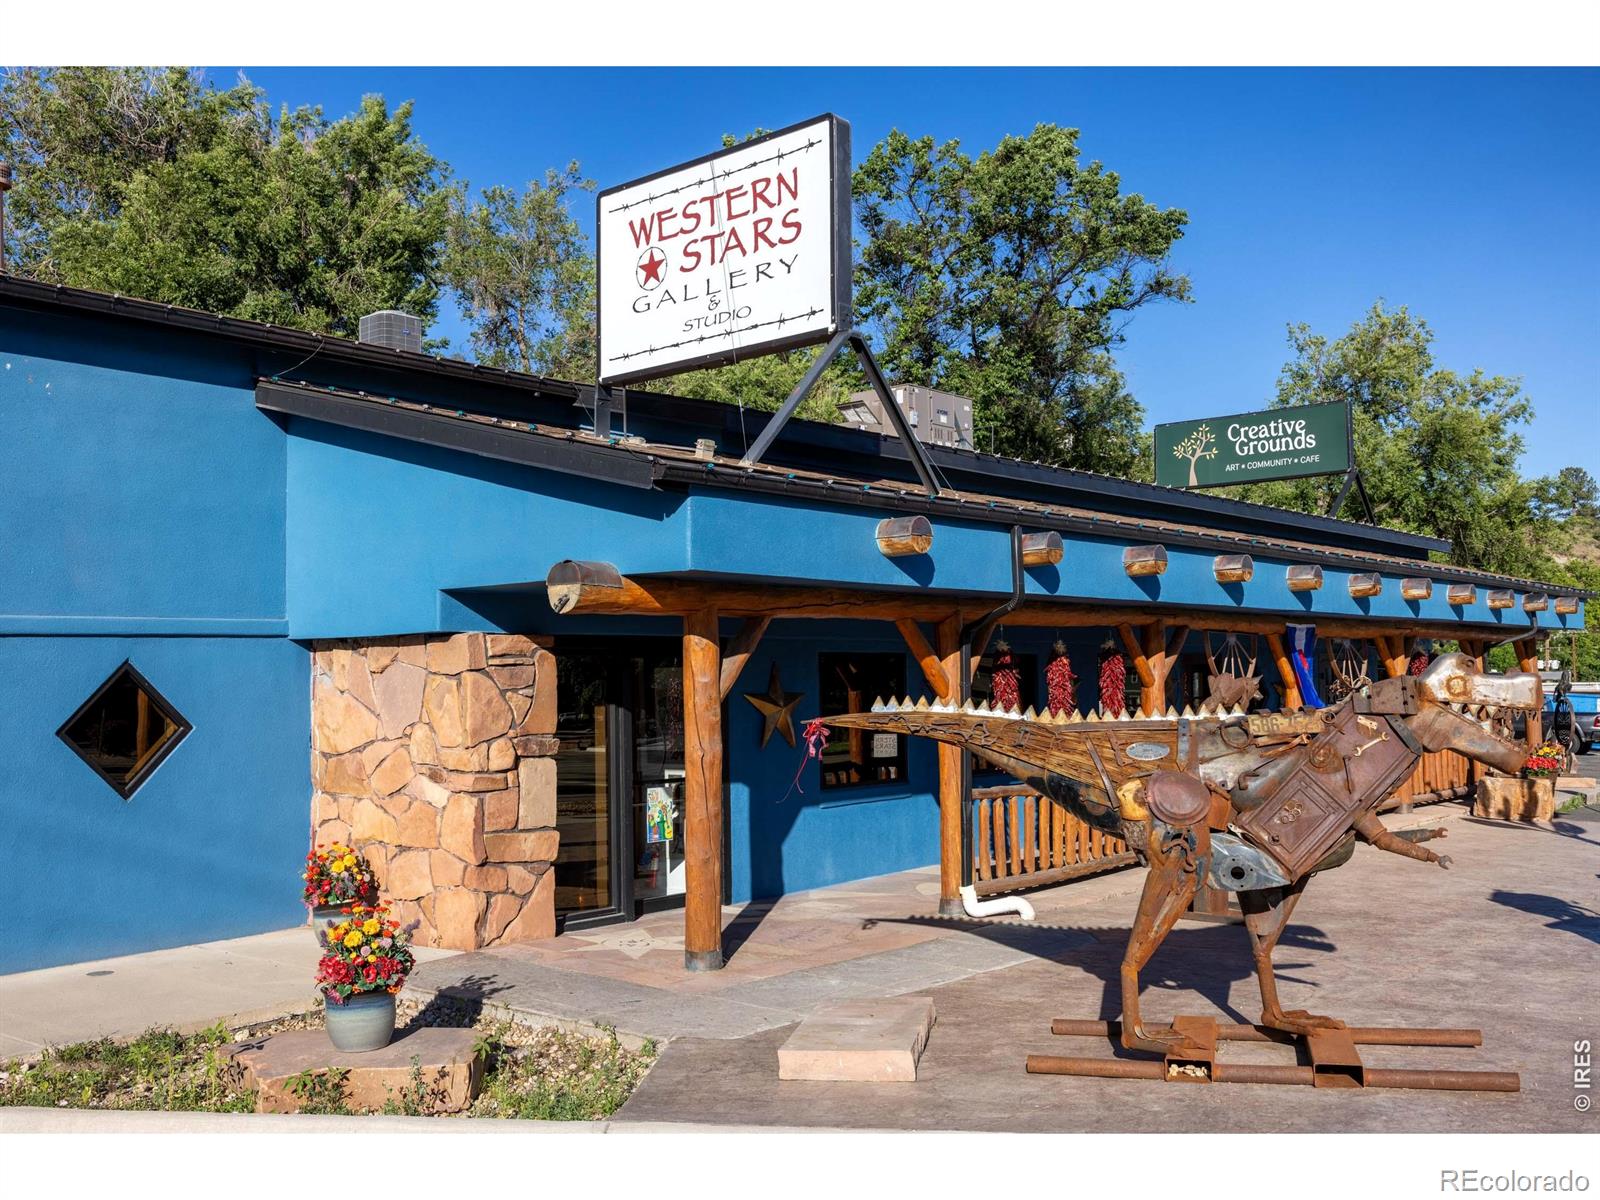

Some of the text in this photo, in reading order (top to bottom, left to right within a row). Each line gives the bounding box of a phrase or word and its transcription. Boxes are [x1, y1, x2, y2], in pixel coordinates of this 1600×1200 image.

[628, 167, 798, 249] WESTERN
[679, 208, 802, 273] STARS
[632, 254, 798, 314] GALLERY
[708, 295, 721, 311] &
[682, 305, 752, 332] STUDIO
[1227, 418, 1306, 442] Creative
[1235, 431, 1316, 456] Grounds
[1225, 454, 1320, 472] ART COMMUNITY CAFE
